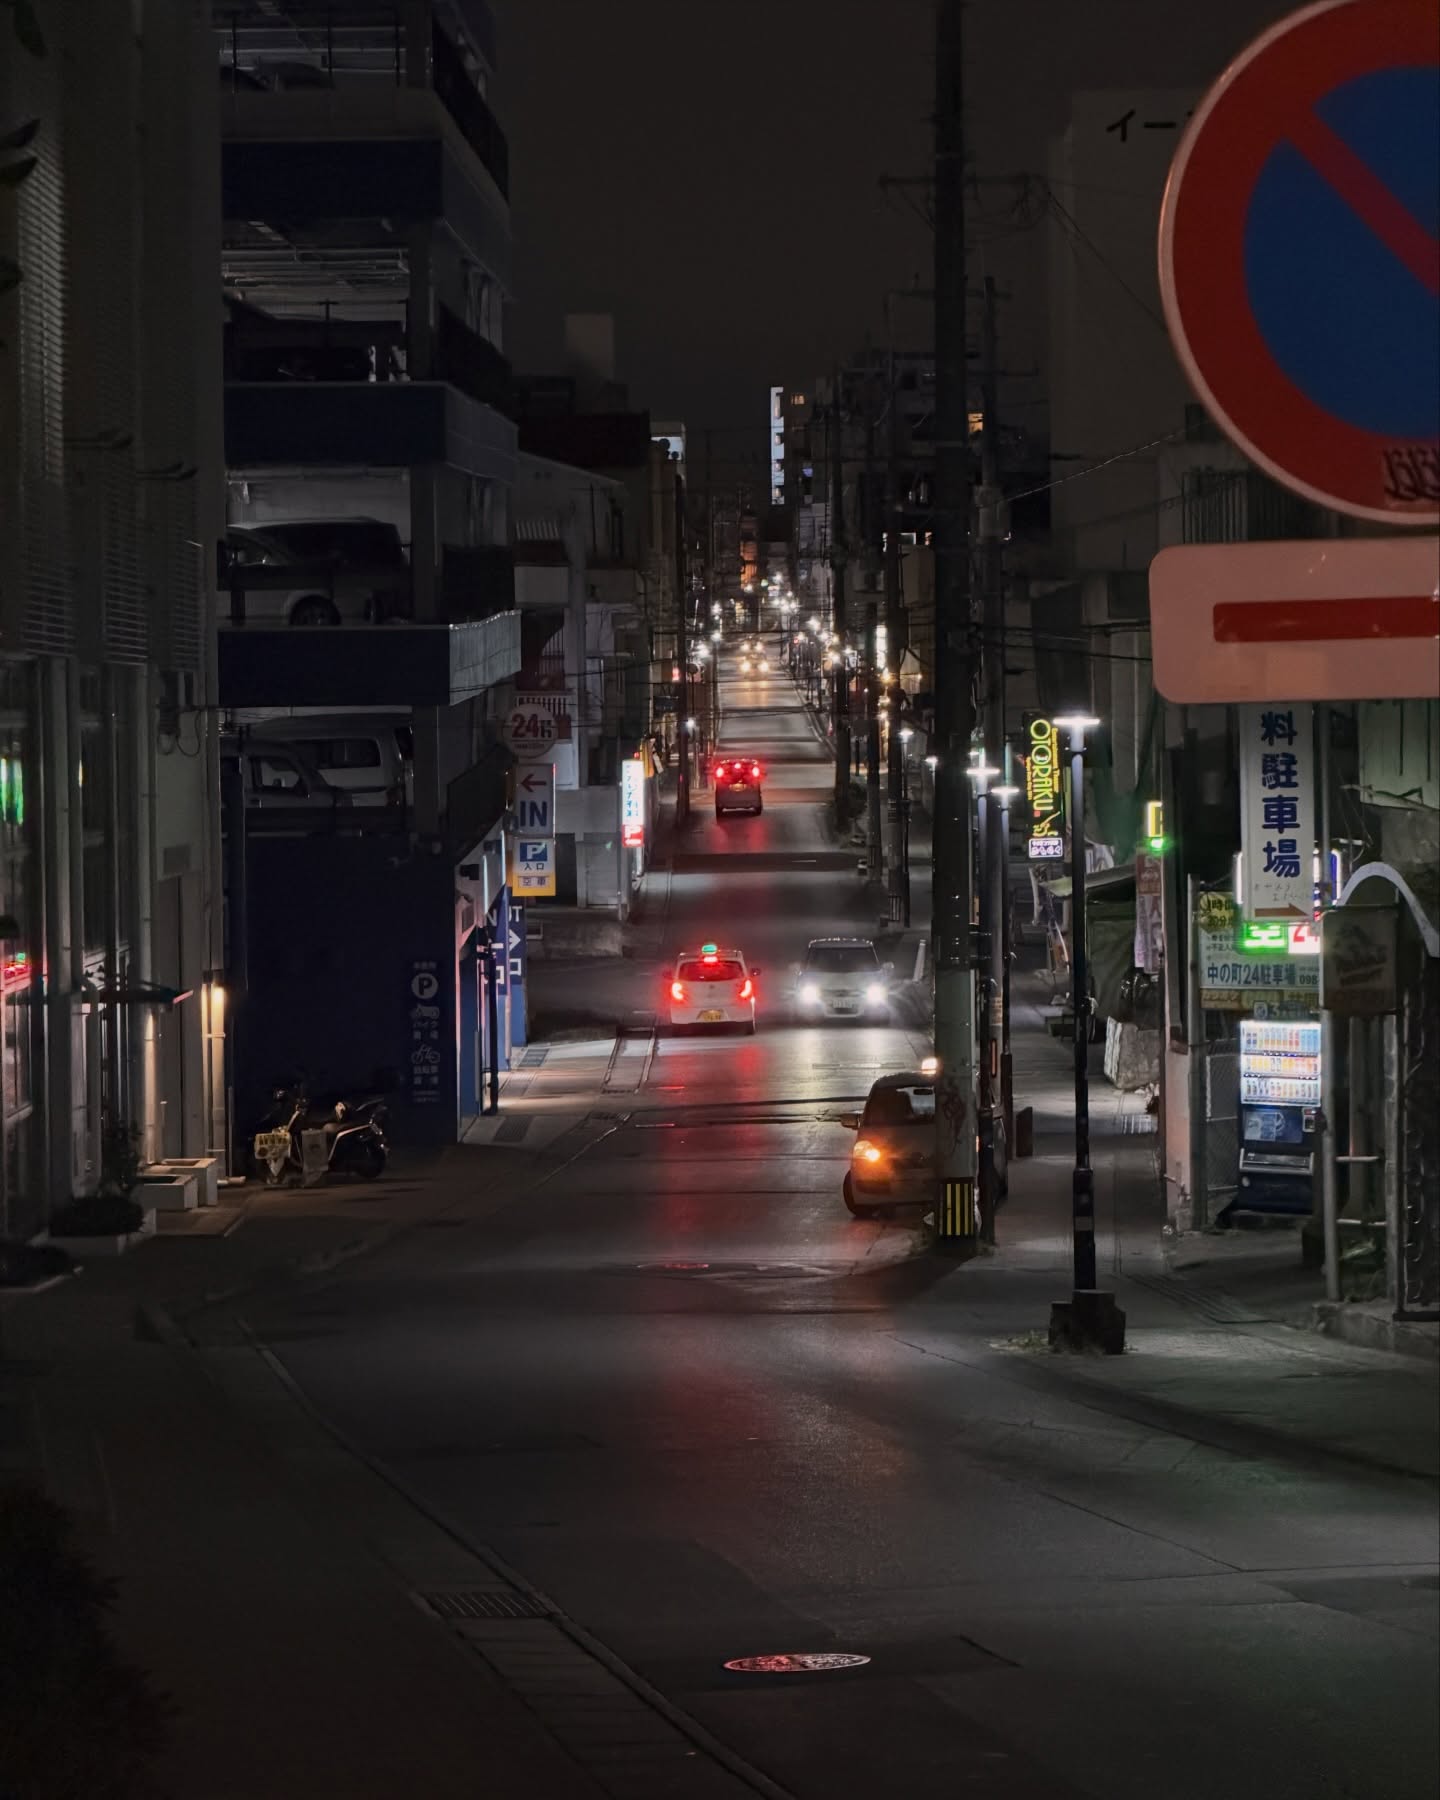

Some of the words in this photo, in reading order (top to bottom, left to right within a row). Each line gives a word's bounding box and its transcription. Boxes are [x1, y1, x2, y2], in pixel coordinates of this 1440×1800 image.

[1030, 719, 1054, 811] OTORAKU
[519, 801, 548, 827] IN
[526, 844, 541, 860] P
[524, 862, 545, 871] 入口
[1207, 963, 1296, 985] 中の町24駐車場
[418, 977, 433, 996] P
